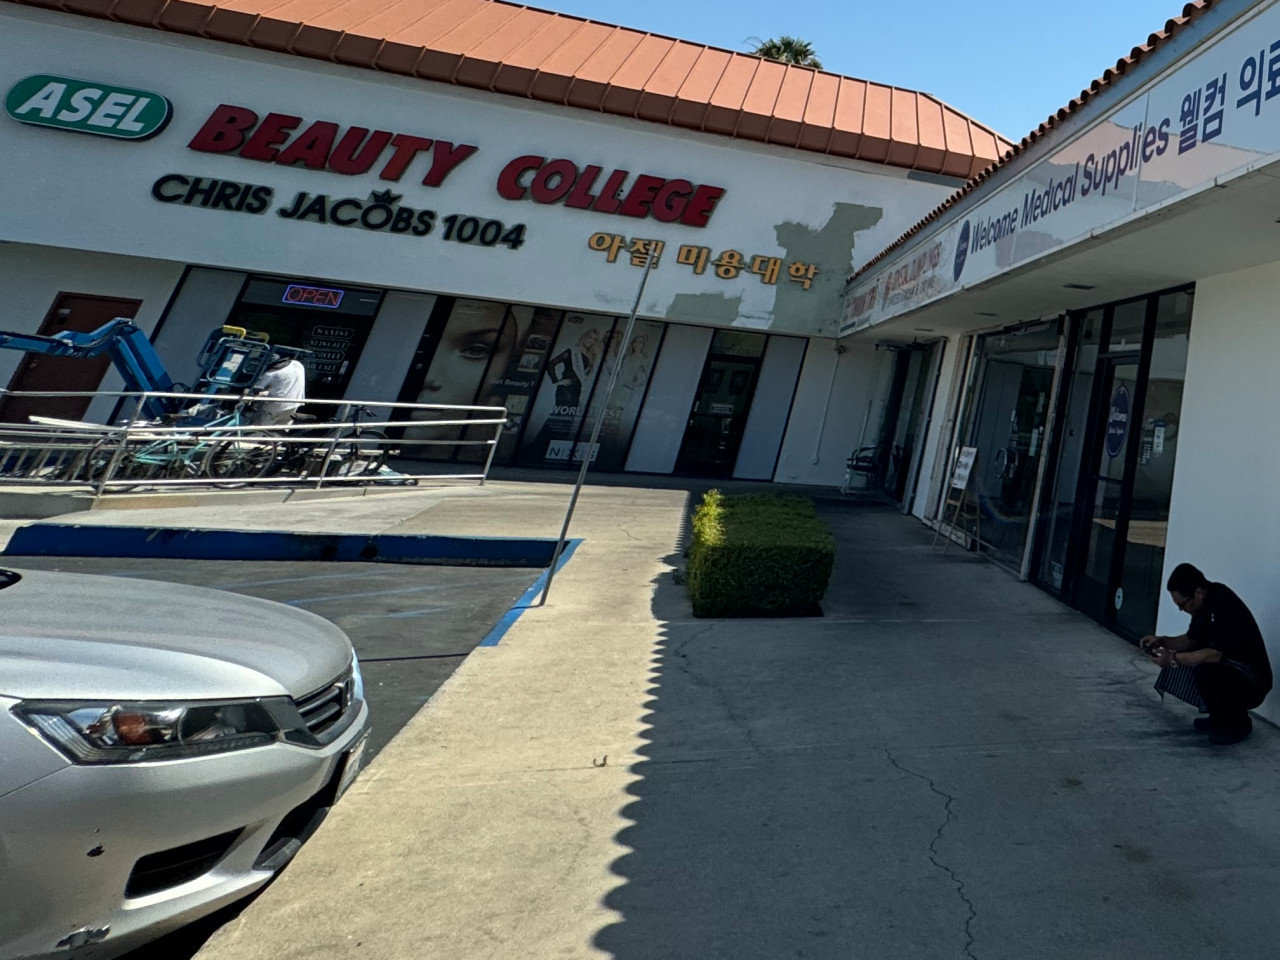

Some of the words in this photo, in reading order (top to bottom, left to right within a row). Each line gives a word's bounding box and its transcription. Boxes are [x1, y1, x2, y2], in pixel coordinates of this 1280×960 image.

[15, 82, 152, 132] ASEL
[1177, 72, 1228, 156] 웰컴
[187, 103, 478, 187] BEAUTY
[496, 154, 726, 228] COLLEGE
[970, 205, 1018, 254] Welcome
[1020, 162, 1080, 229] Medical
[1081, 117, 1171, 197] Supplies
[152, 174, 273, 214] CHRIS
[279, 190, 436, 236] JACOBS
[443, 214, 525, 249] 1004
[287, 287, 341, 306] OPEN
[677, 245, 819, 289] 미용대학
[550, 404, 592, 418] WORL
